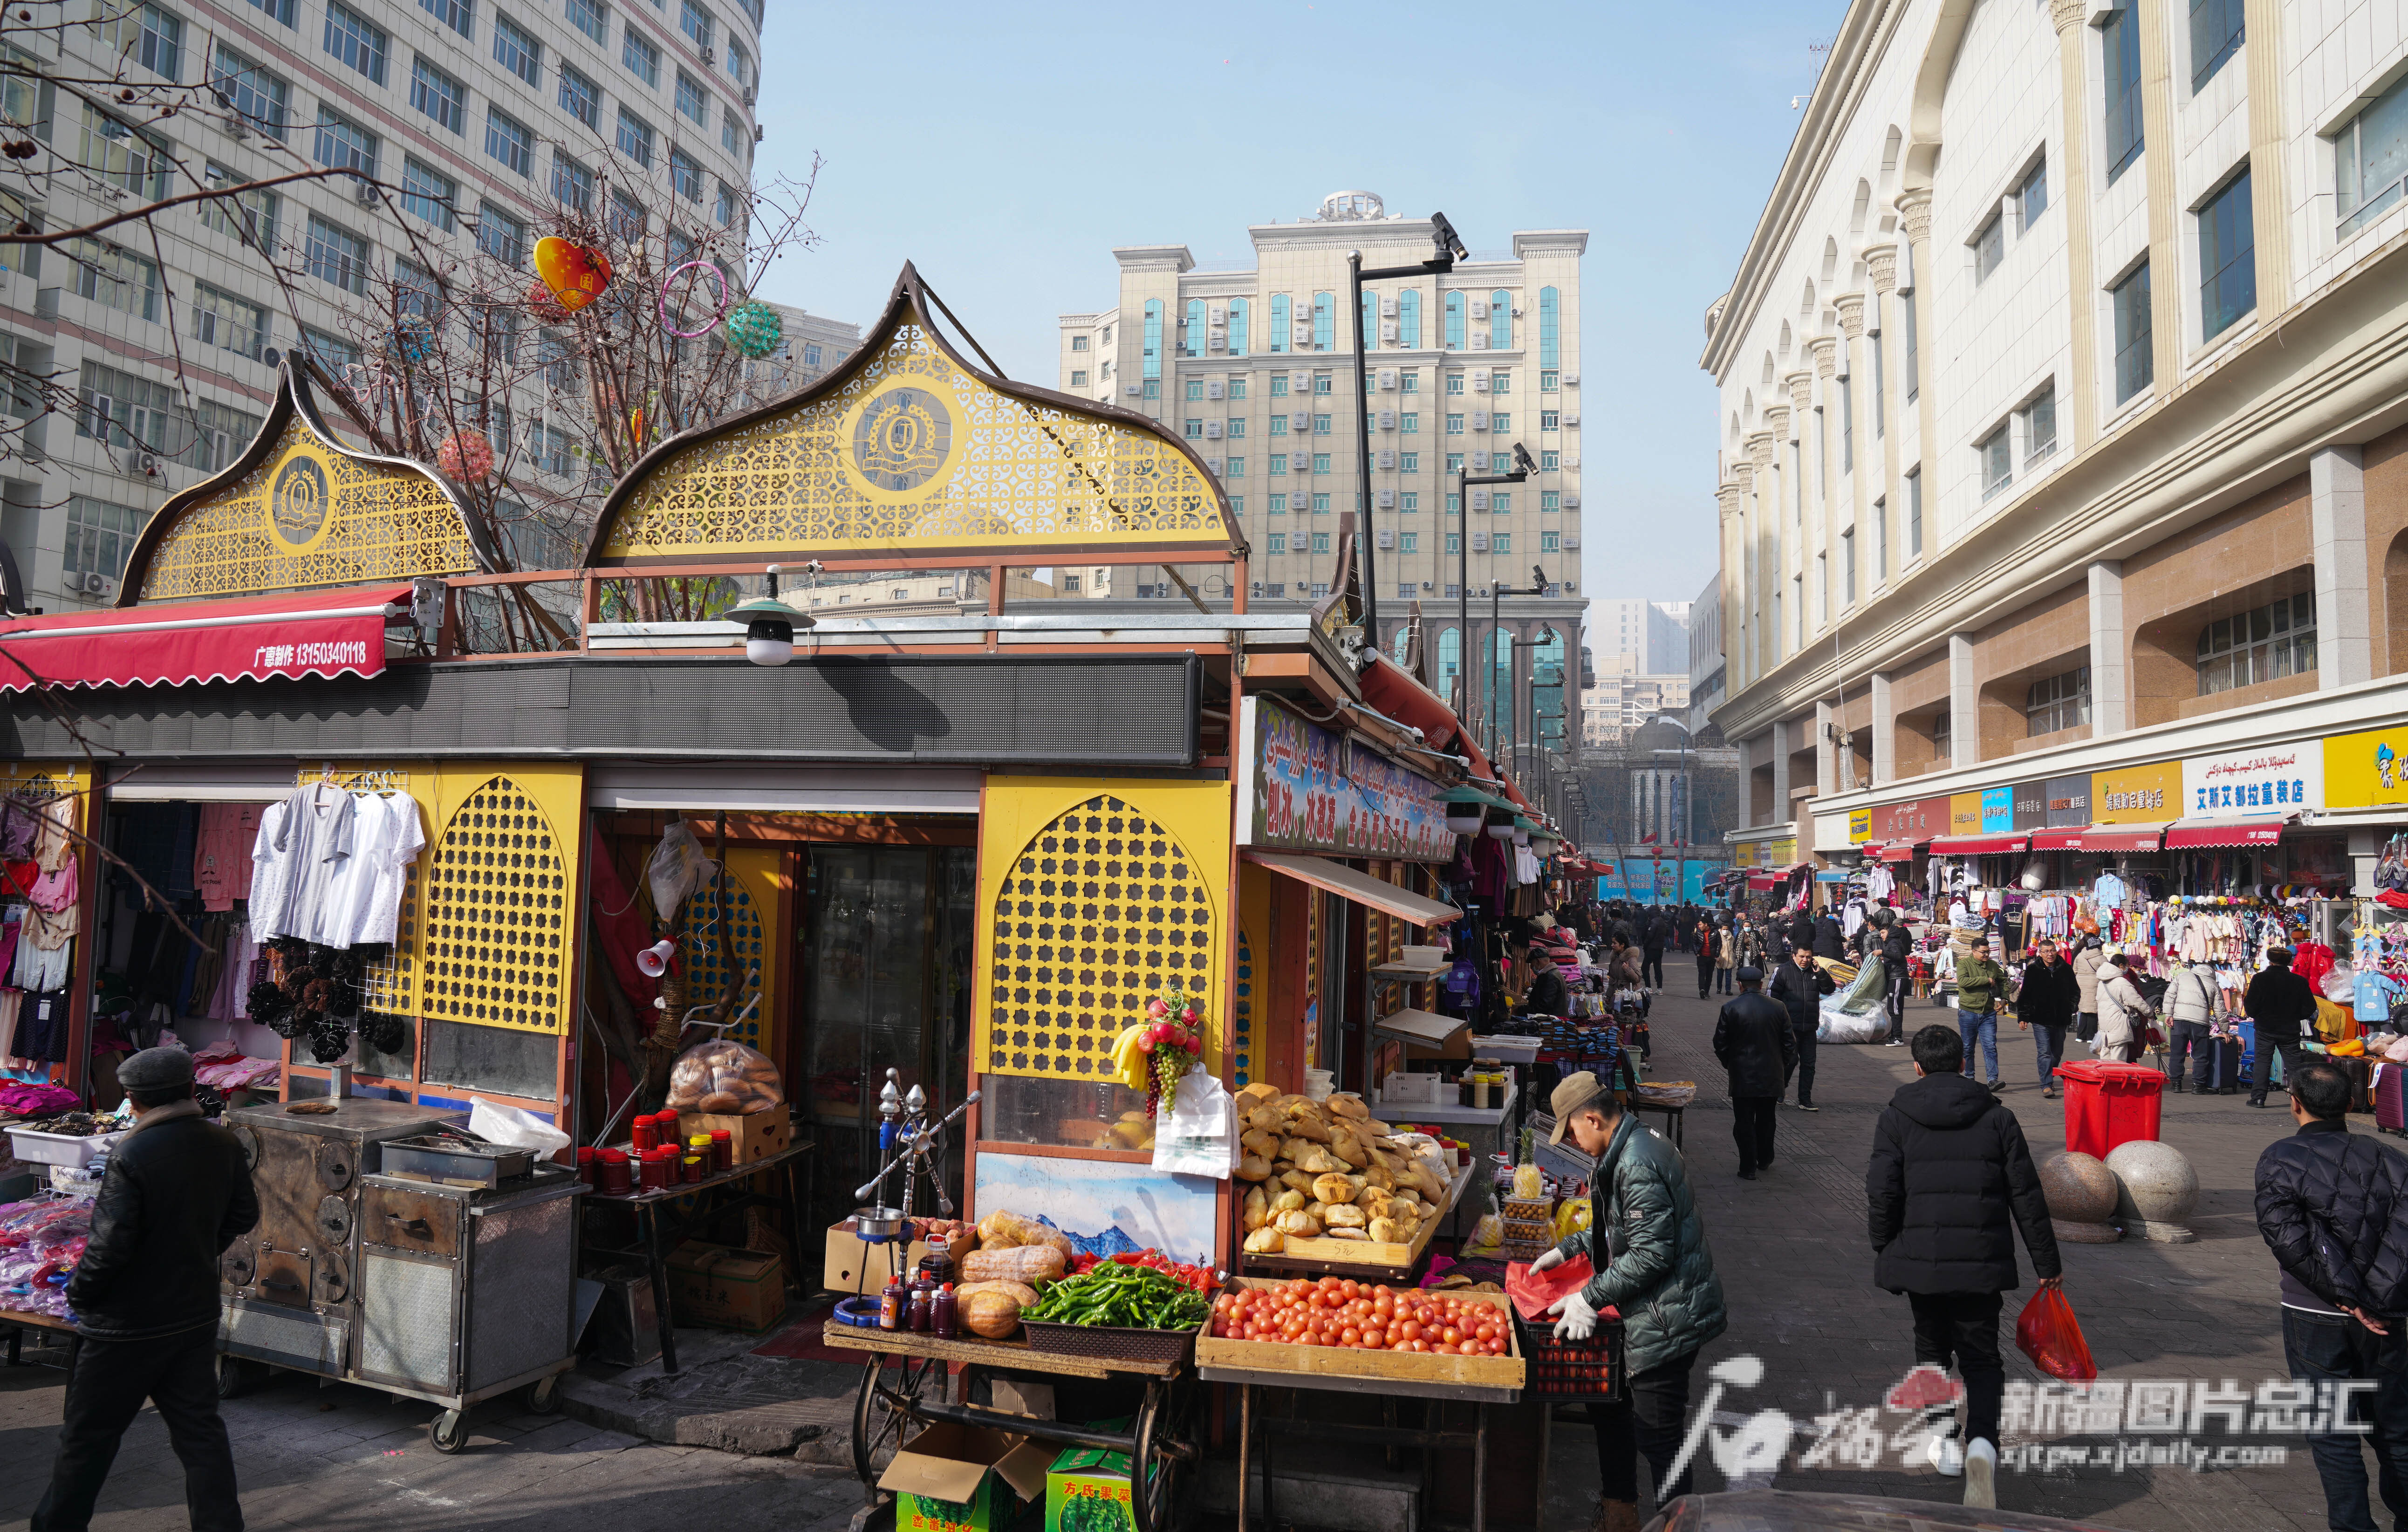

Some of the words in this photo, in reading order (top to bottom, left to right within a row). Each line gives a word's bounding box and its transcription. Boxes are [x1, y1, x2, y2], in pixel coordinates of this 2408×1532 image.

[254, 644, 294, 668] 广惠制作
[296, 641, 366, 665] 13150340118
[2197, 779, 2304, 810] 艾斯艾都拉童装店
[1063, 1481, 1132, 1503] 方氏果菜
